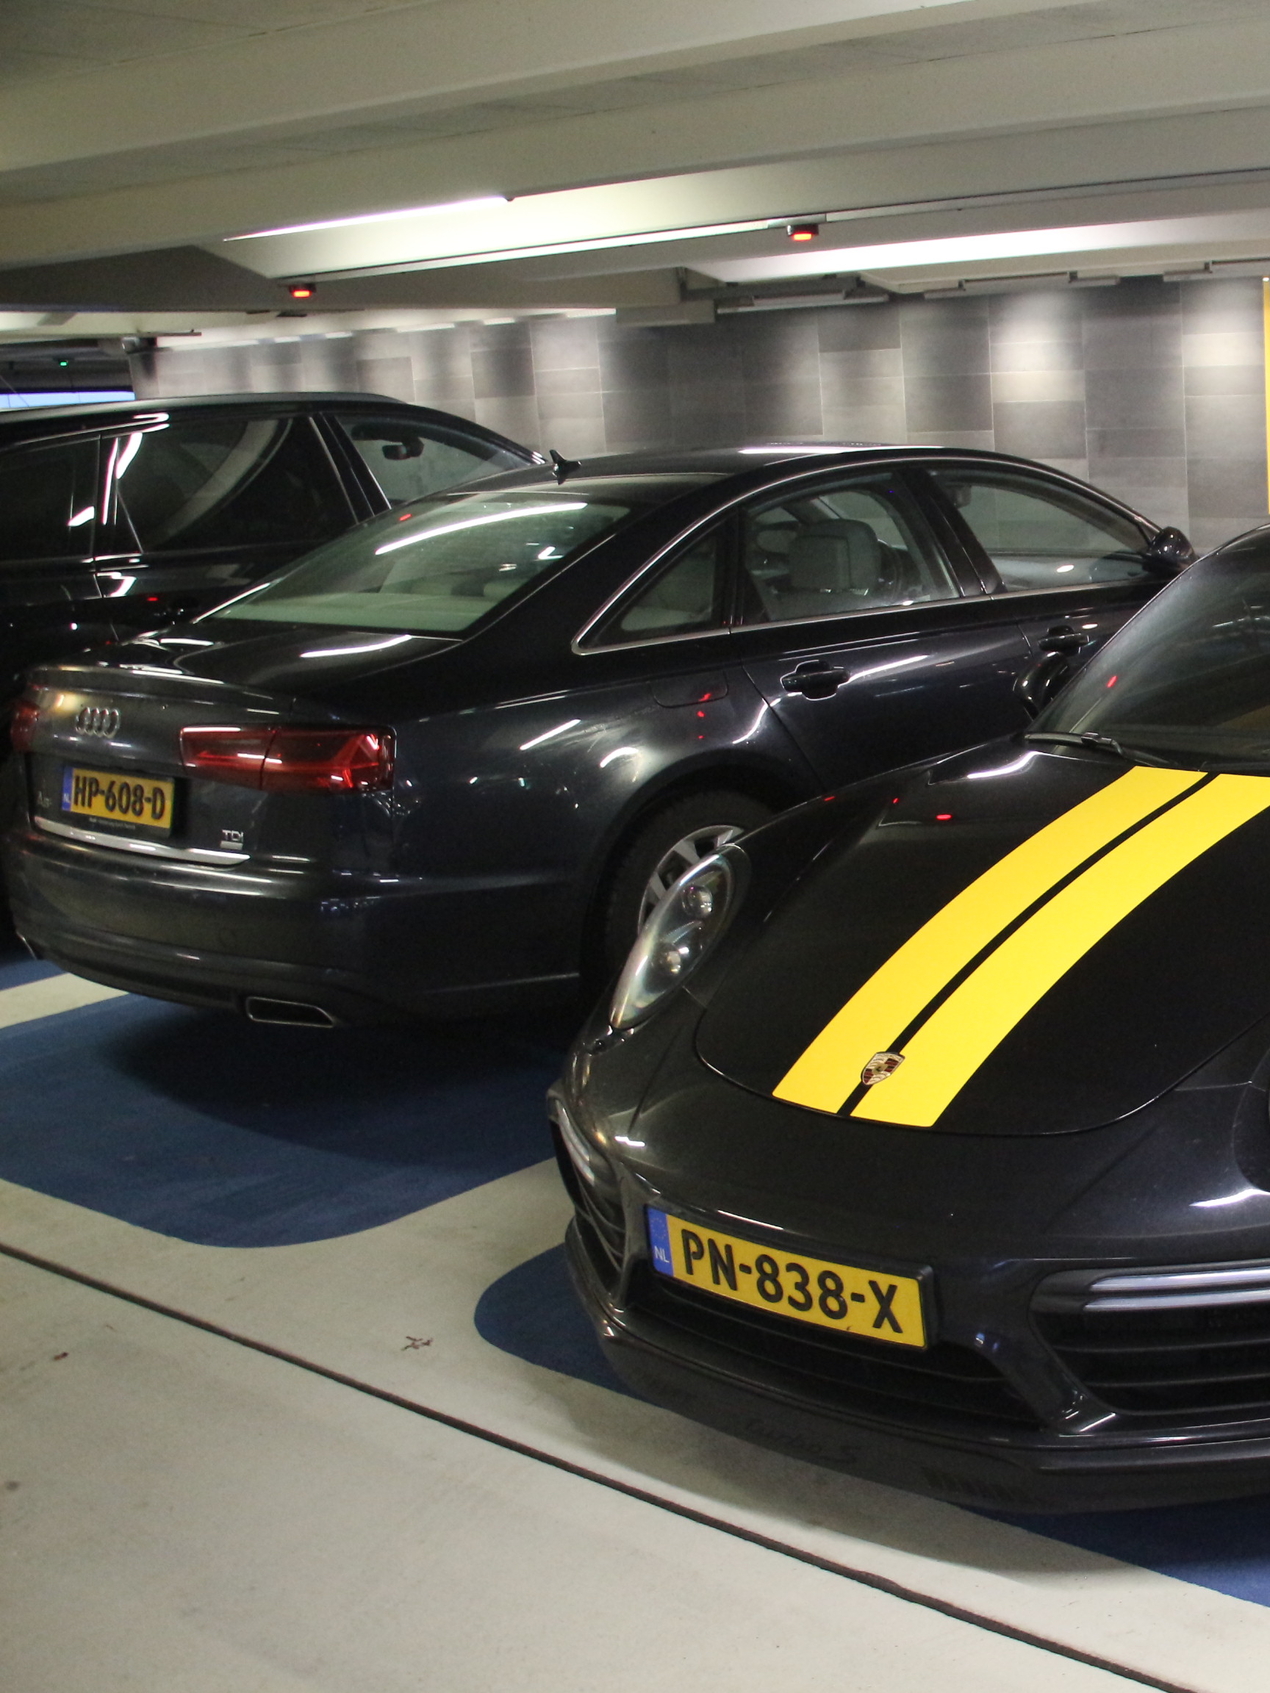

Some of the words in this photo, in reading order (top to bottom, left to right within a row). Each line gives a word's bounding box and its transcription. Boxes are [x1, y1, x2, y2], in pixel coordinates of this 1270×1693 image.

[73, 775, 166, 821] HP-608-D
[222, 829, 244, 842] TDI
[654, 1246, 670, 1264] NL
[681, 1228, 904, 1334] PN-838-X
